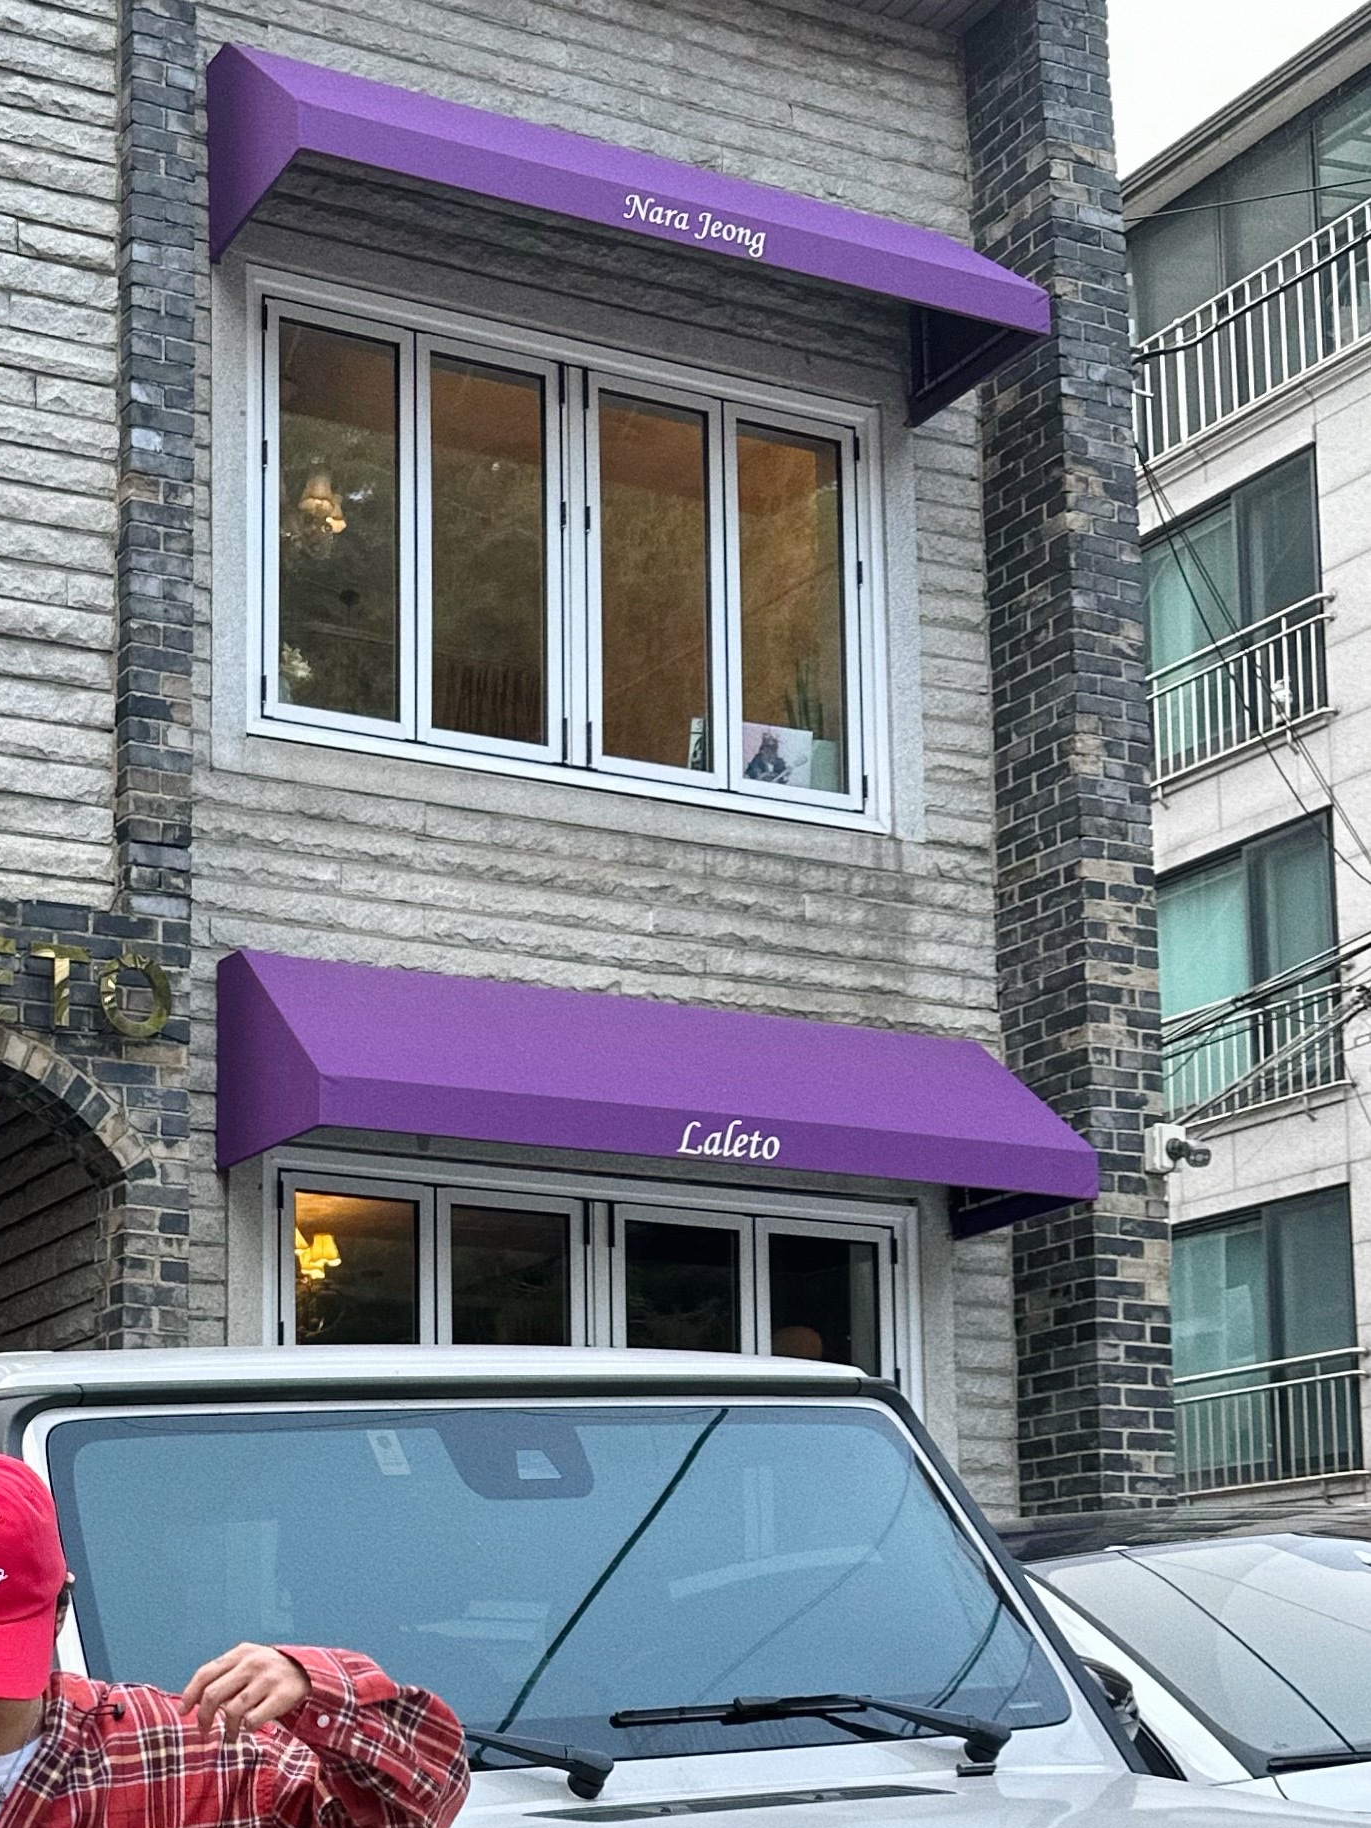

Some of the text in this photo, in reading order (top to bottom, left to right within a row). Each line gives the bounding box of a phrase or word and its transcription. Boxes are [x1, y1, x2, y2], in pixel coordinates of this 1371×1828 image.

[623, 194, 766, 258] Nara Jeong
[676, 1119, 781, 1160] Laleto
